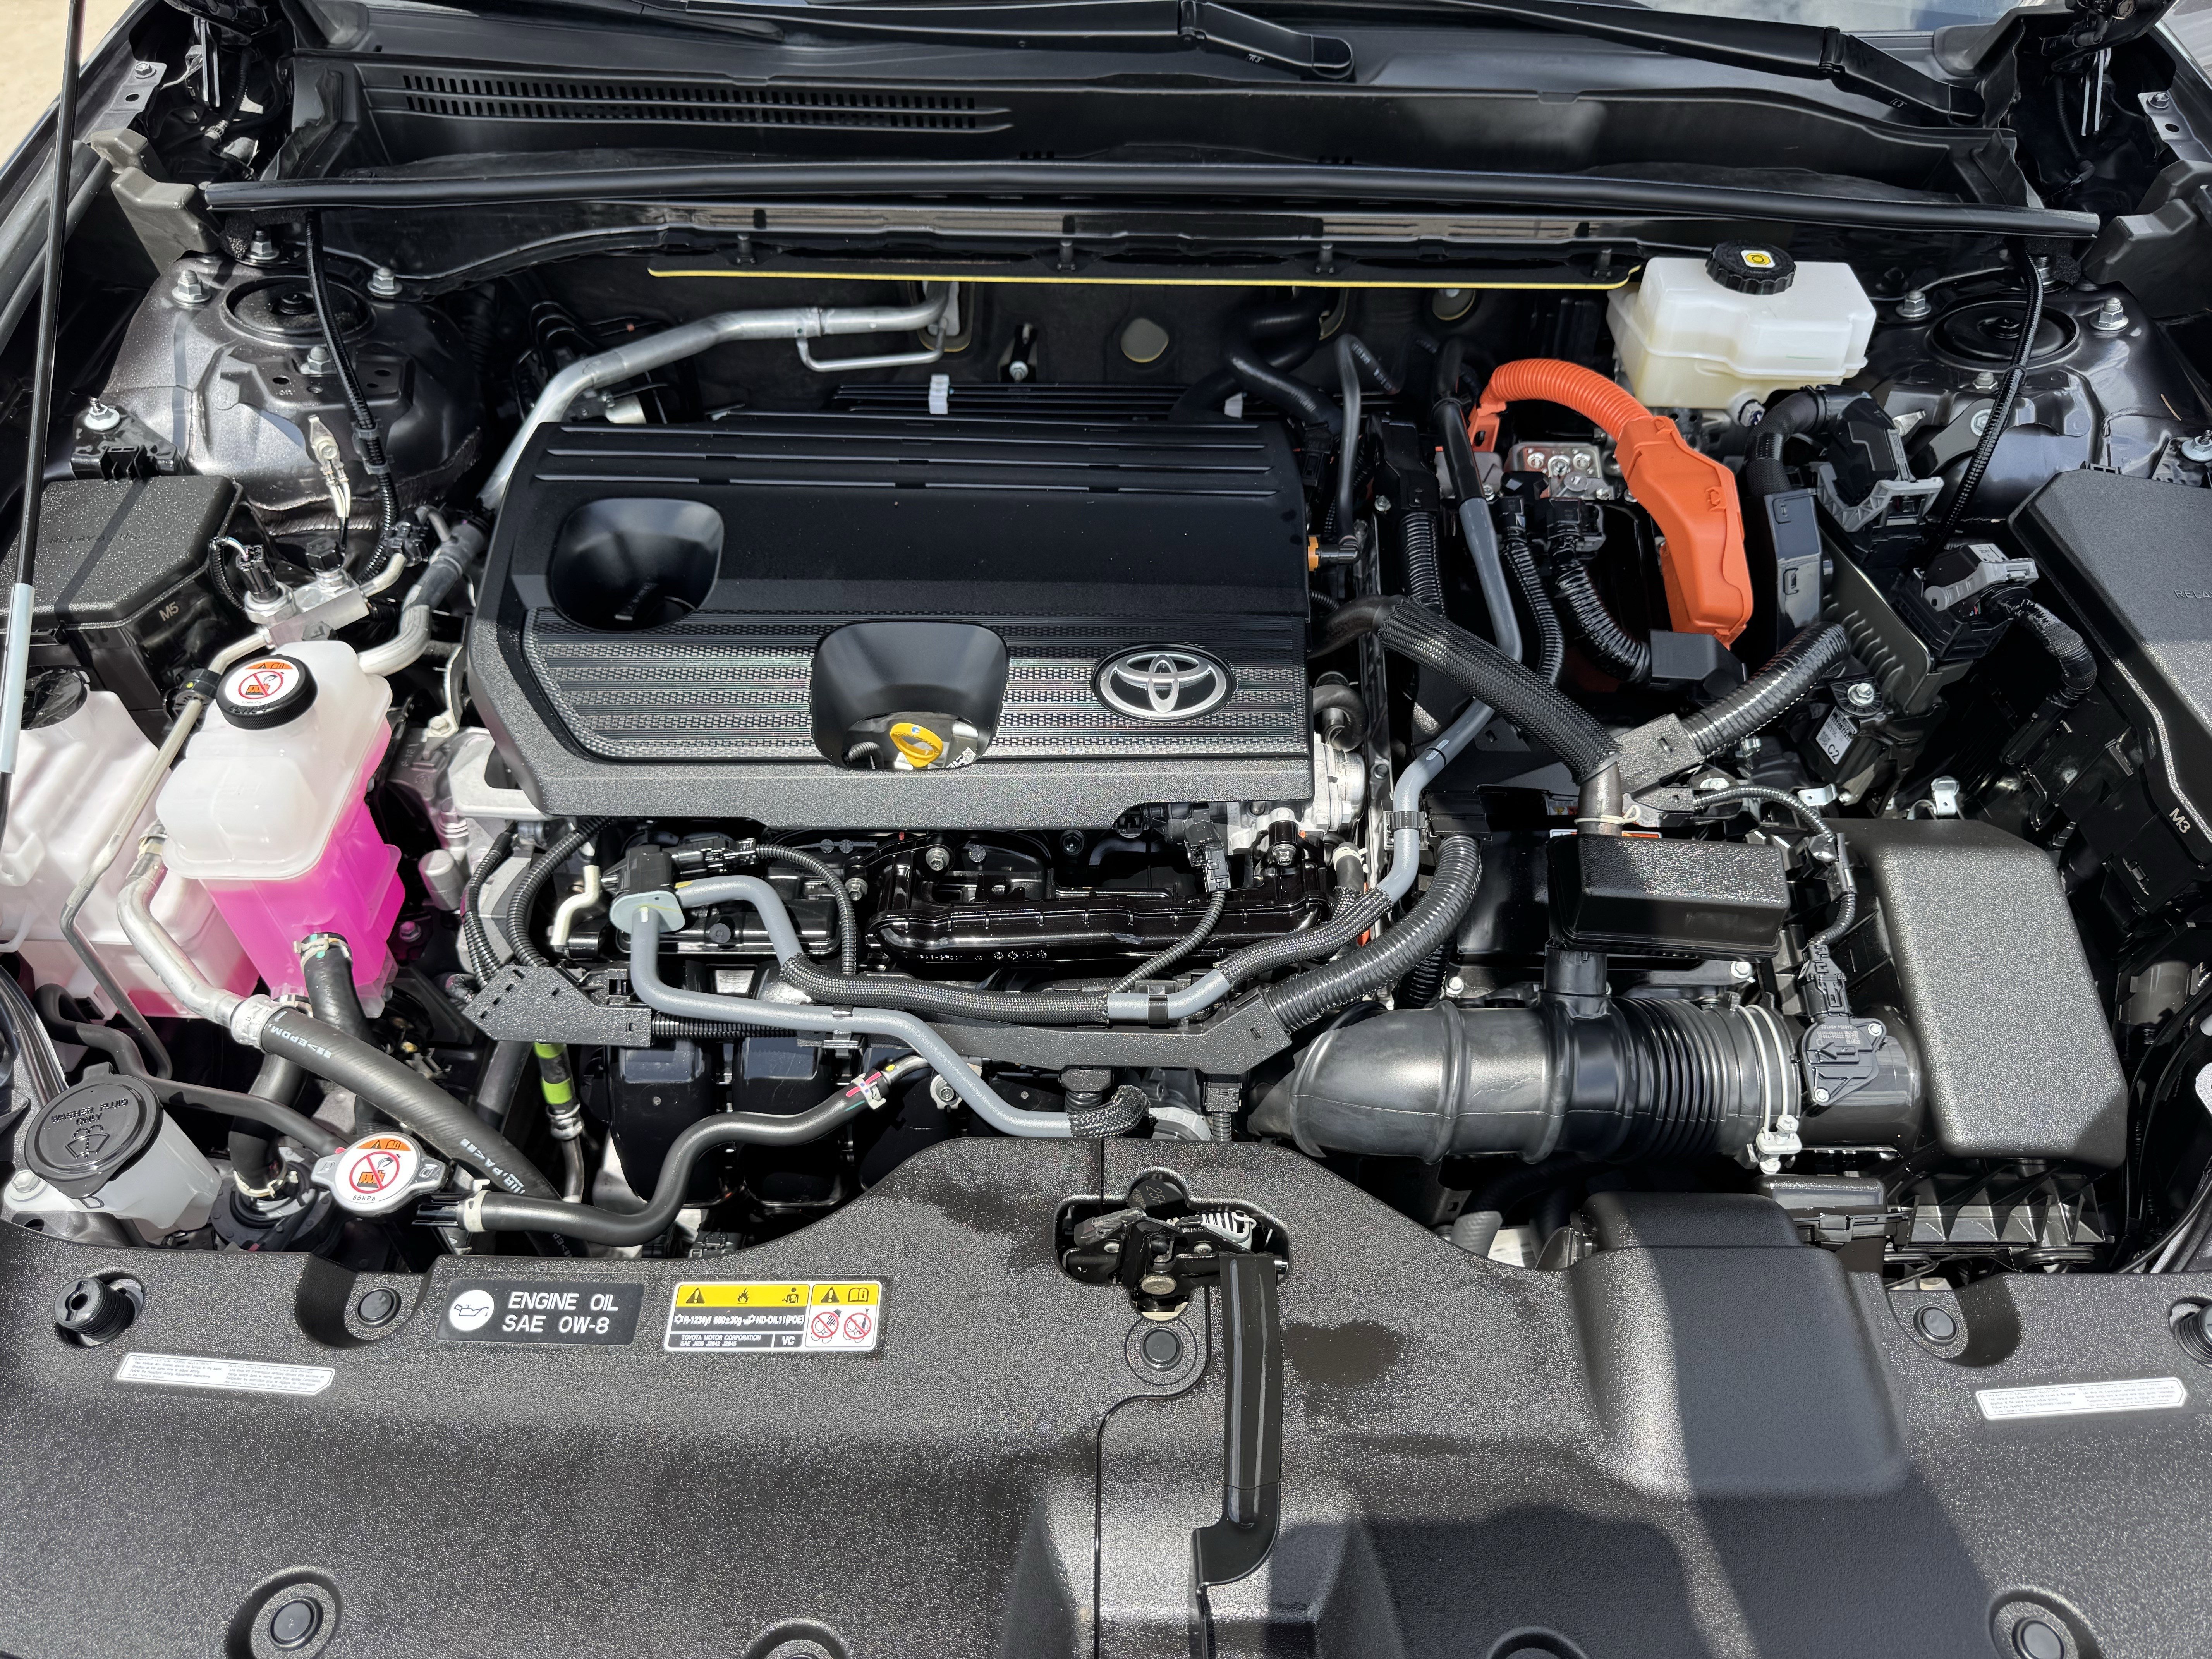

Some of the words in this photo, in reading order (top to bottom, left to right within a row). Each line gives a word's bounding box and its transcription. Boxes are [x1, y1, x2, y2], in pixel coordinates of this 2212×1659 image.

[159, 601, 179, 622] M5
[1828, 744, 1839, 761] C2
[2169, 807, 2190, 833] M3
[100, 1098, 129, 1112] FLUID
[76, 1112, 103, 1126] ONLY
[508, 1291, 580, 1310] ENGINE
[590, 1293, 619, 1311] OIL
[502, 1314, 546, 1332] SAE
[558, 1316, 610, 1334] 0W-8
[781, 1334, 795, 1346] VC
